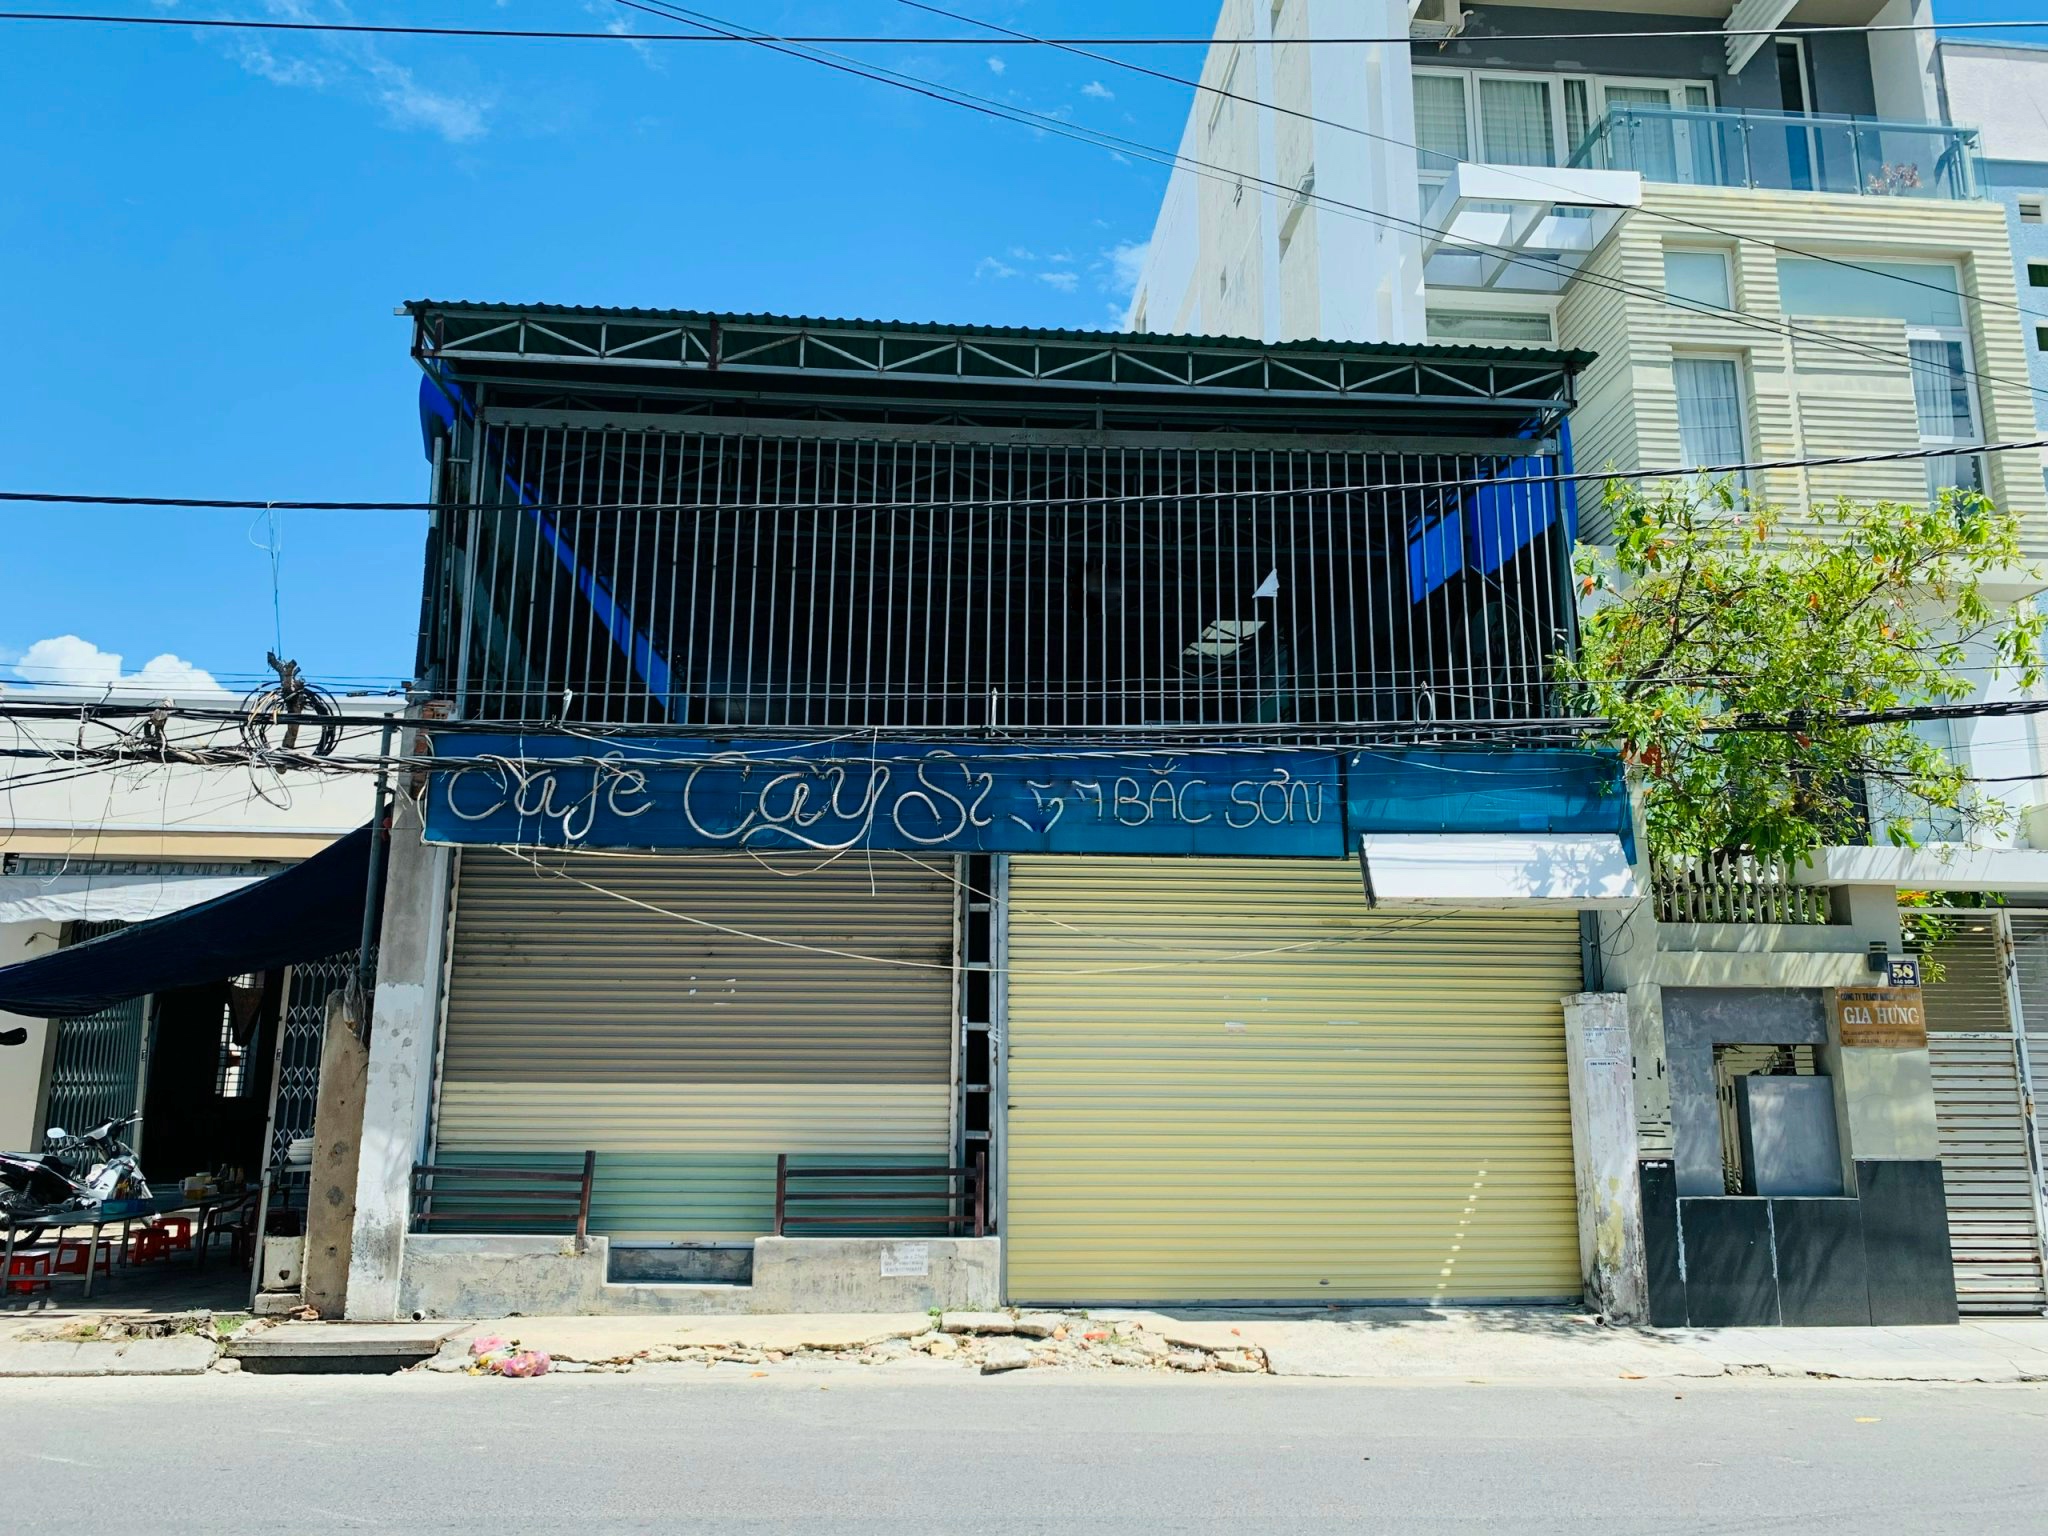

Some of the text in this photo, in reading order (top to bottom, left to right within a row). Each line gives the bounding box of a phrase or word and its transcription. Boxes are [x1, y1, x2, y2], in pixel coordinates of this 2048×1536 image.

[1114, 758, 1212, 827] BẮC
[1892, 964, 1914, 978] 58
[1843, 1004, 1920, 1025] GIA HƯNG
